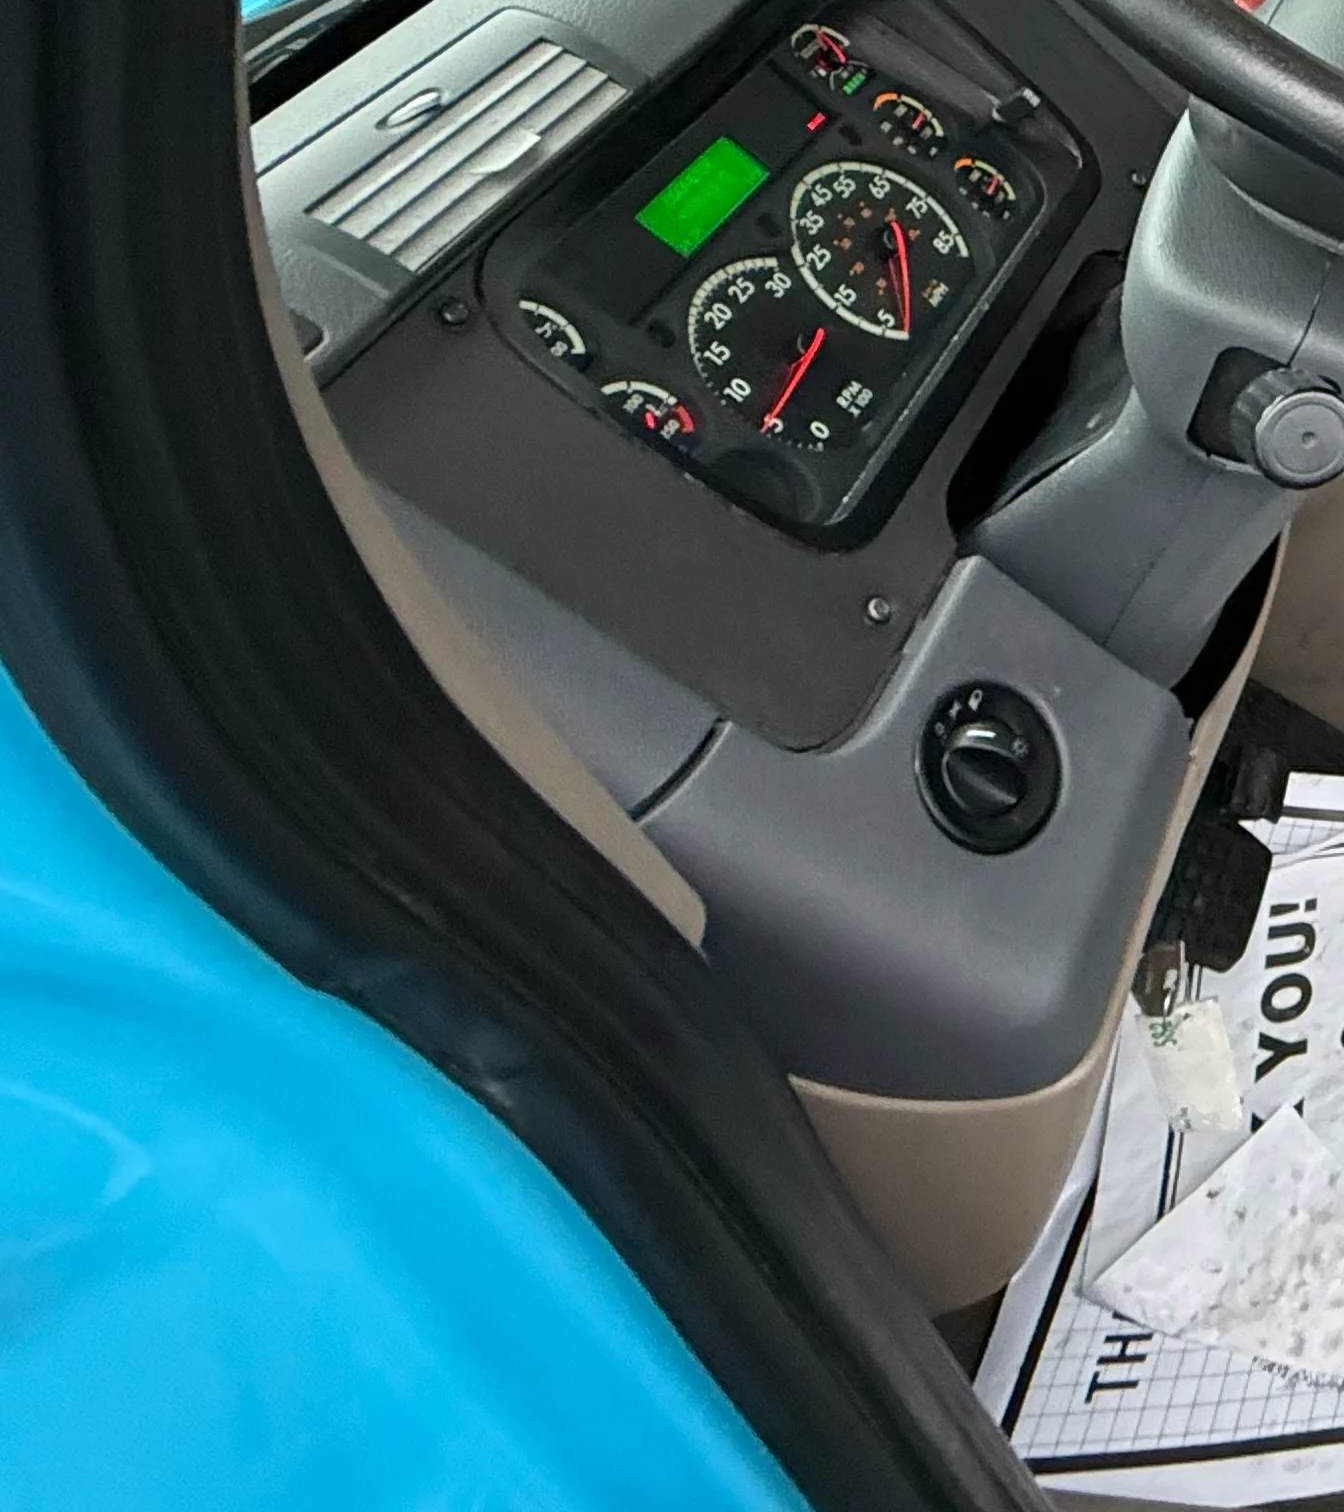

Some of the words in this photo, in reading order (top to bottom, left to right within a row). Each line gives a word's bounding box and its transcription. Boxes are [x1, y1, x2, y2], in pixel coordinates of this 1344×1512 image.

[811, 184, 833, 207] 45
[833, 175, 856, 199] 55
[869, 175, 891, 199] 65
[905, 195, 928, 219] 75
[799, 209, 825, 236] 35
[932, 230, 954, 255] 85
[806, 244, 832, 271] 25
[727, 277, 755, 304] 25
[765, 272, 792, 298] 30
[833, 284, 857, 307] 15
[704, 303, 733, 330] 20
[877, 308, 896, 328] 5
[703, 341, 731, 366] 15
[723, 377, 752, 403] 10
[836, 380, 862, 409] RPM
[854, 388, 874, 409] 100
[810, 420, 830, 439] 0
[1254, 897, 1318, 1085] YOU!
